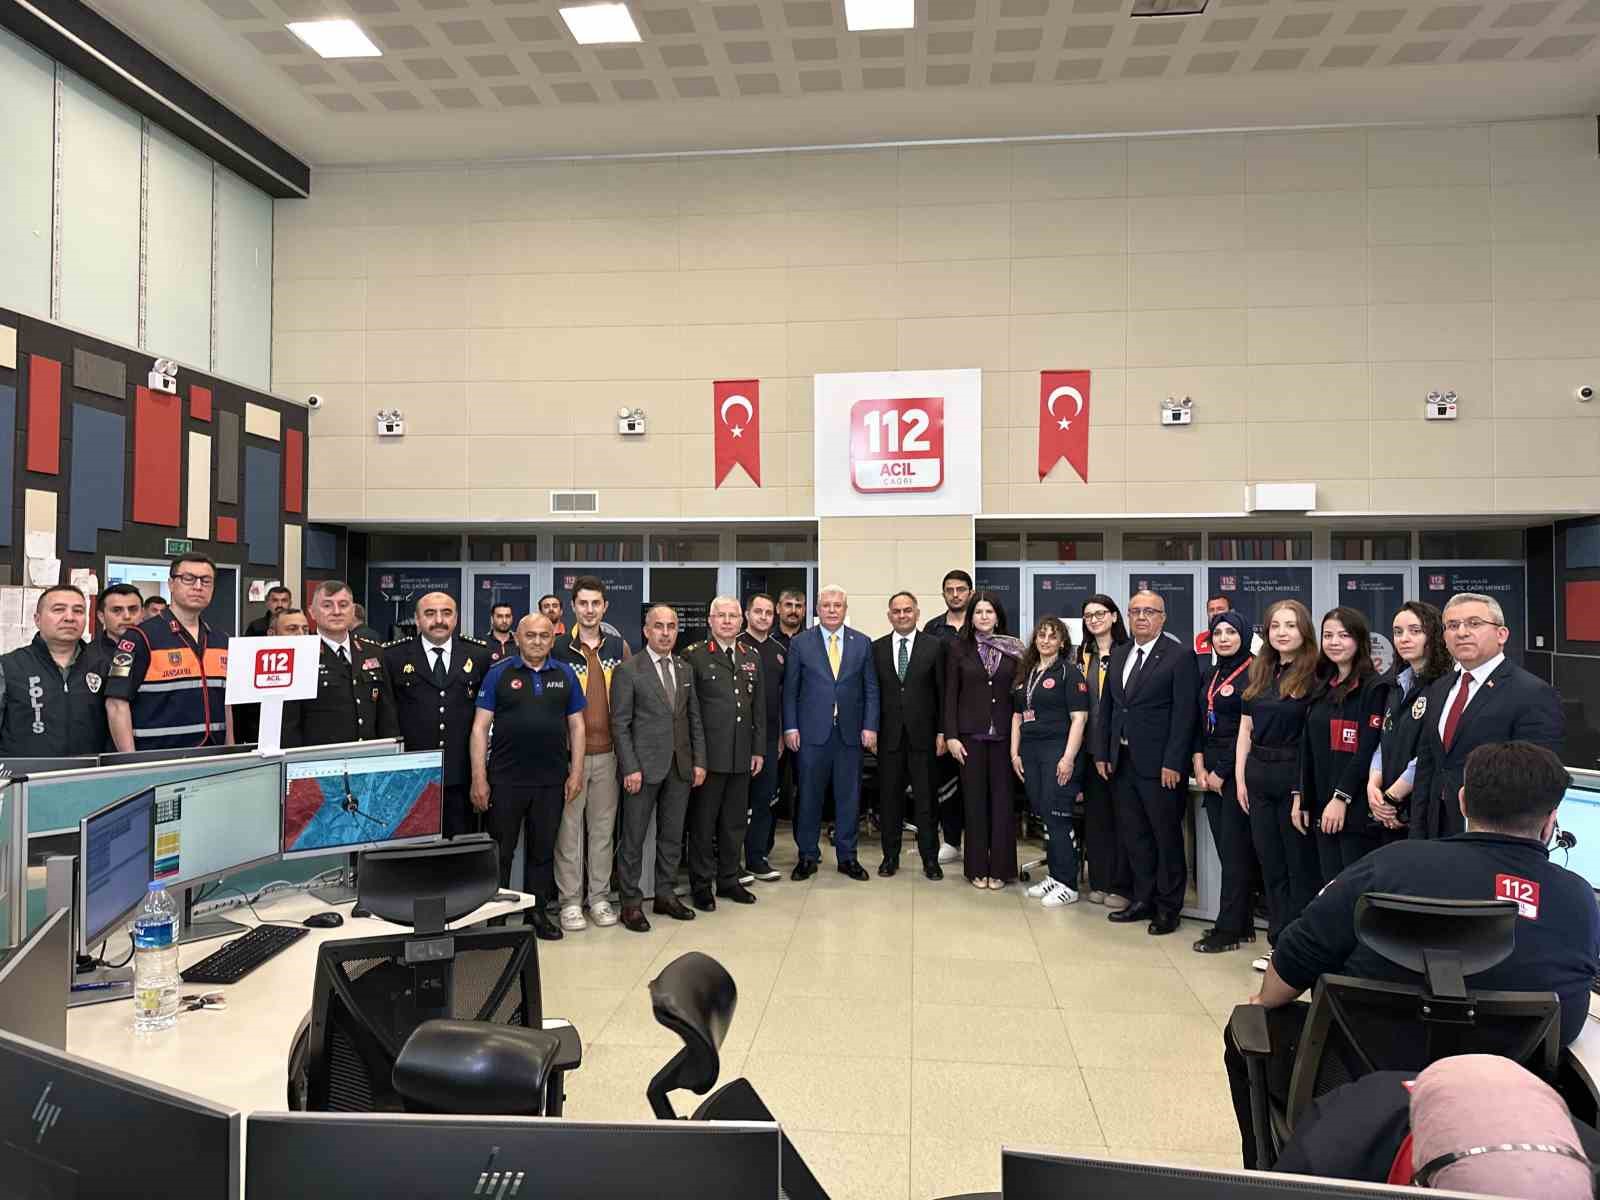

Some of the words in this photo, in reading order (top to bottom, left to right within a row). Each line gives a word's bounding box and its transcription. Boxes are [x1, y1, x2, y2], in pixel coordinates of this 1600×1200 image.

[863, 408, 931, 454] 112
[880, 462, 916, 477] ACİL
[261, 652, 289, 673] 112
[28, 675, 45, 734] POLİS
[1501, 878, 1536, 903] 112
